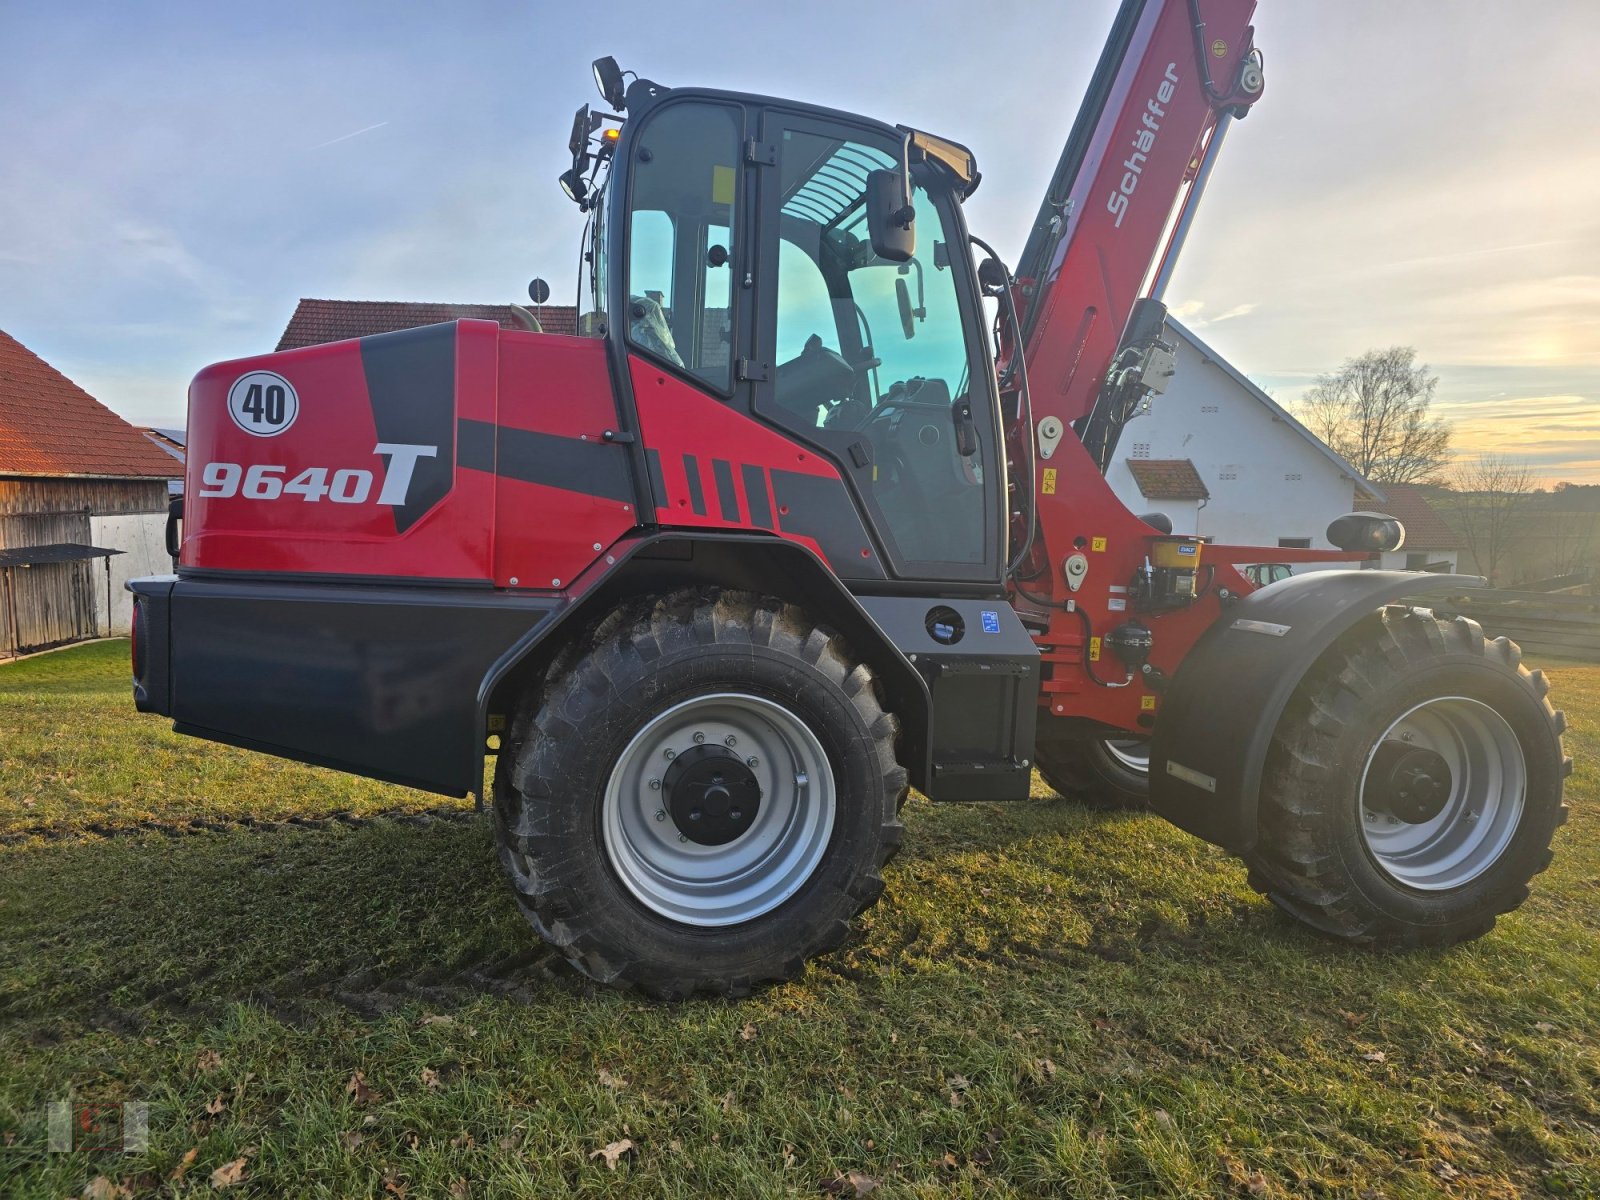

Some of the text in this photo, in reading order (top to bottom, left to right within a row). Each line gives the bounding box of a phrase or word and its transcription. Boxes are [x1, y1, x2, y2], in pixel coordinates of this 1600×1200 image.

[1106, 62, 1178, 228] Schäffer
[242, 384, 286, 425] 40
[198, 442, 438, 506] 9640T
